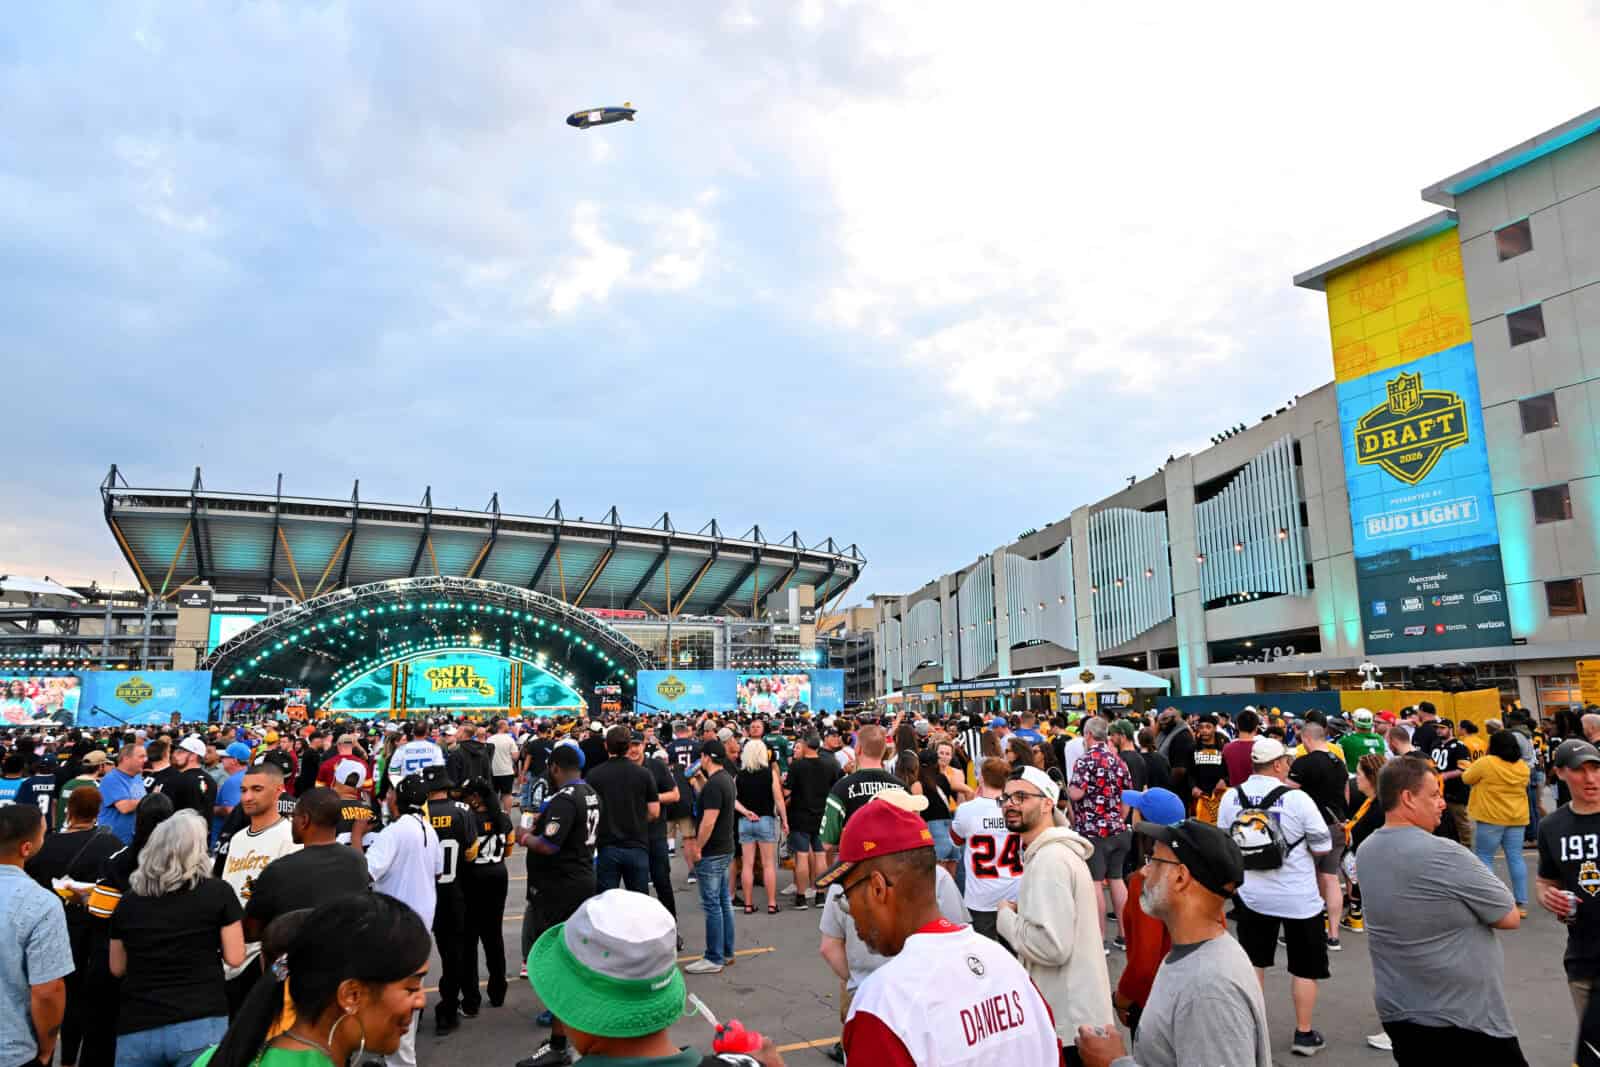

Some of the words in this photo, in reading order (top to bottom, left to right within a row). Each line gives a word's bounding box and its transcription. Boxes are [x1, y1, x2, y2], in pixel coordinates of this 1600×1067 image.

[1391, 389, 1418, 410] NFL
[1364, 413, 1456, 453] DRAFT
[1400, 451, 1424, 464] 2026
[1368, 514, 1408, 535] BUD
[1411, 501, 1473, 526] LIGHT
[1408, 571, 1449, 584] Abercrombie
[1422, 581, 1440, 591] Fitch
[1476, 620, 1505, 630] verizon
[1432, 747, 1449, 770] 90
[983, 817, 1006, 829] CHUB
[969, 833, 1024, 878] 24
[959, 990, 1024, 1047] DANIELS
